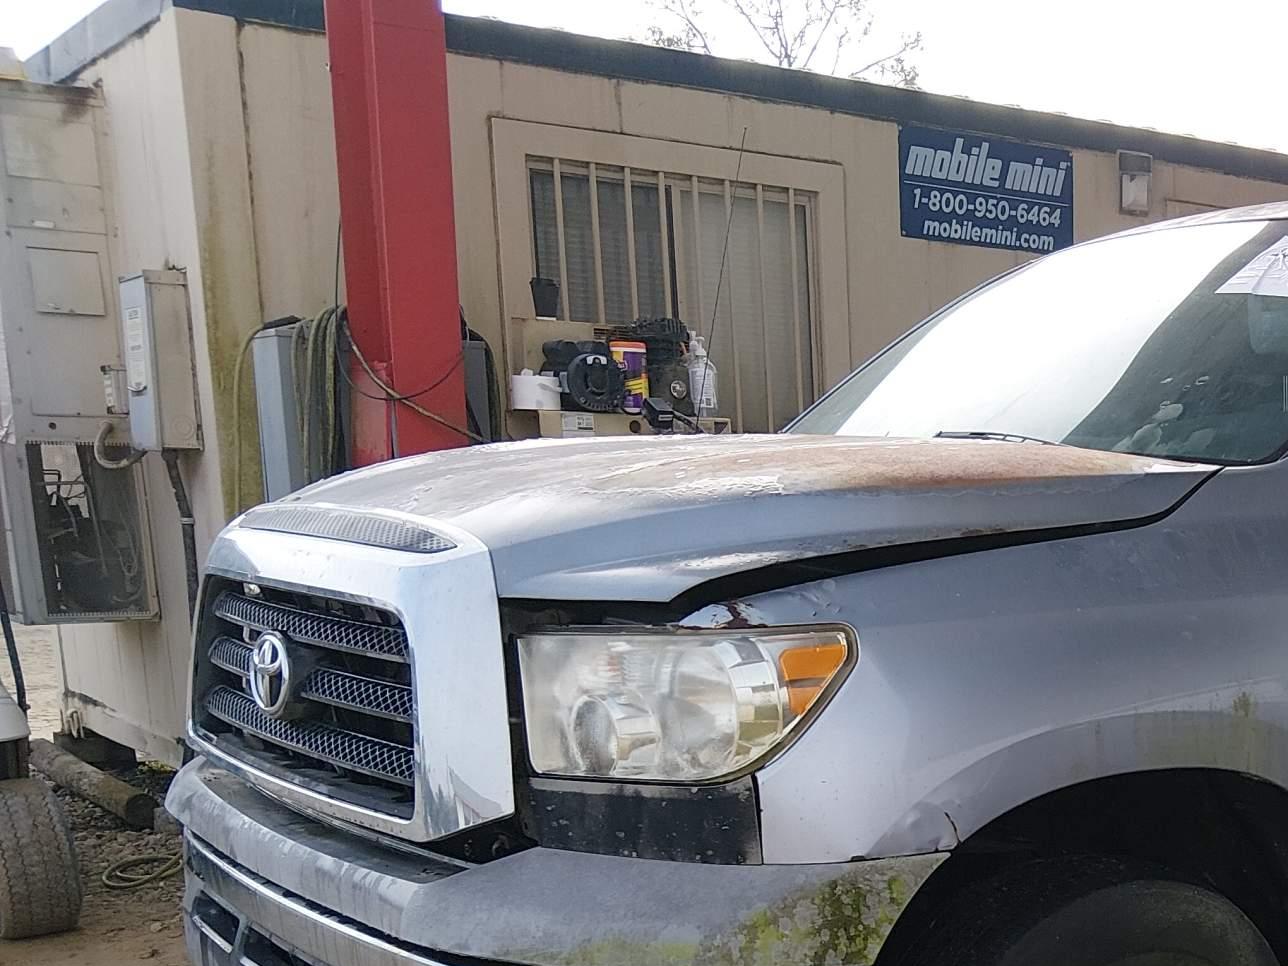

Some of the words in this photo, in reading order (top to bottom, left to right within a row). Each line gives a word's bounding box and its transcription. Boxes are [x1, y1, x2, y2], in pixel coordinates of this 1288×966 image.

[905, 138, 1002, 187] mobile
[1005, 158, 1066, 197] mini
[914, 188, 1061, 227] 1-800-950-6464
[923, 219, 1054, 250] mobilemini.com
